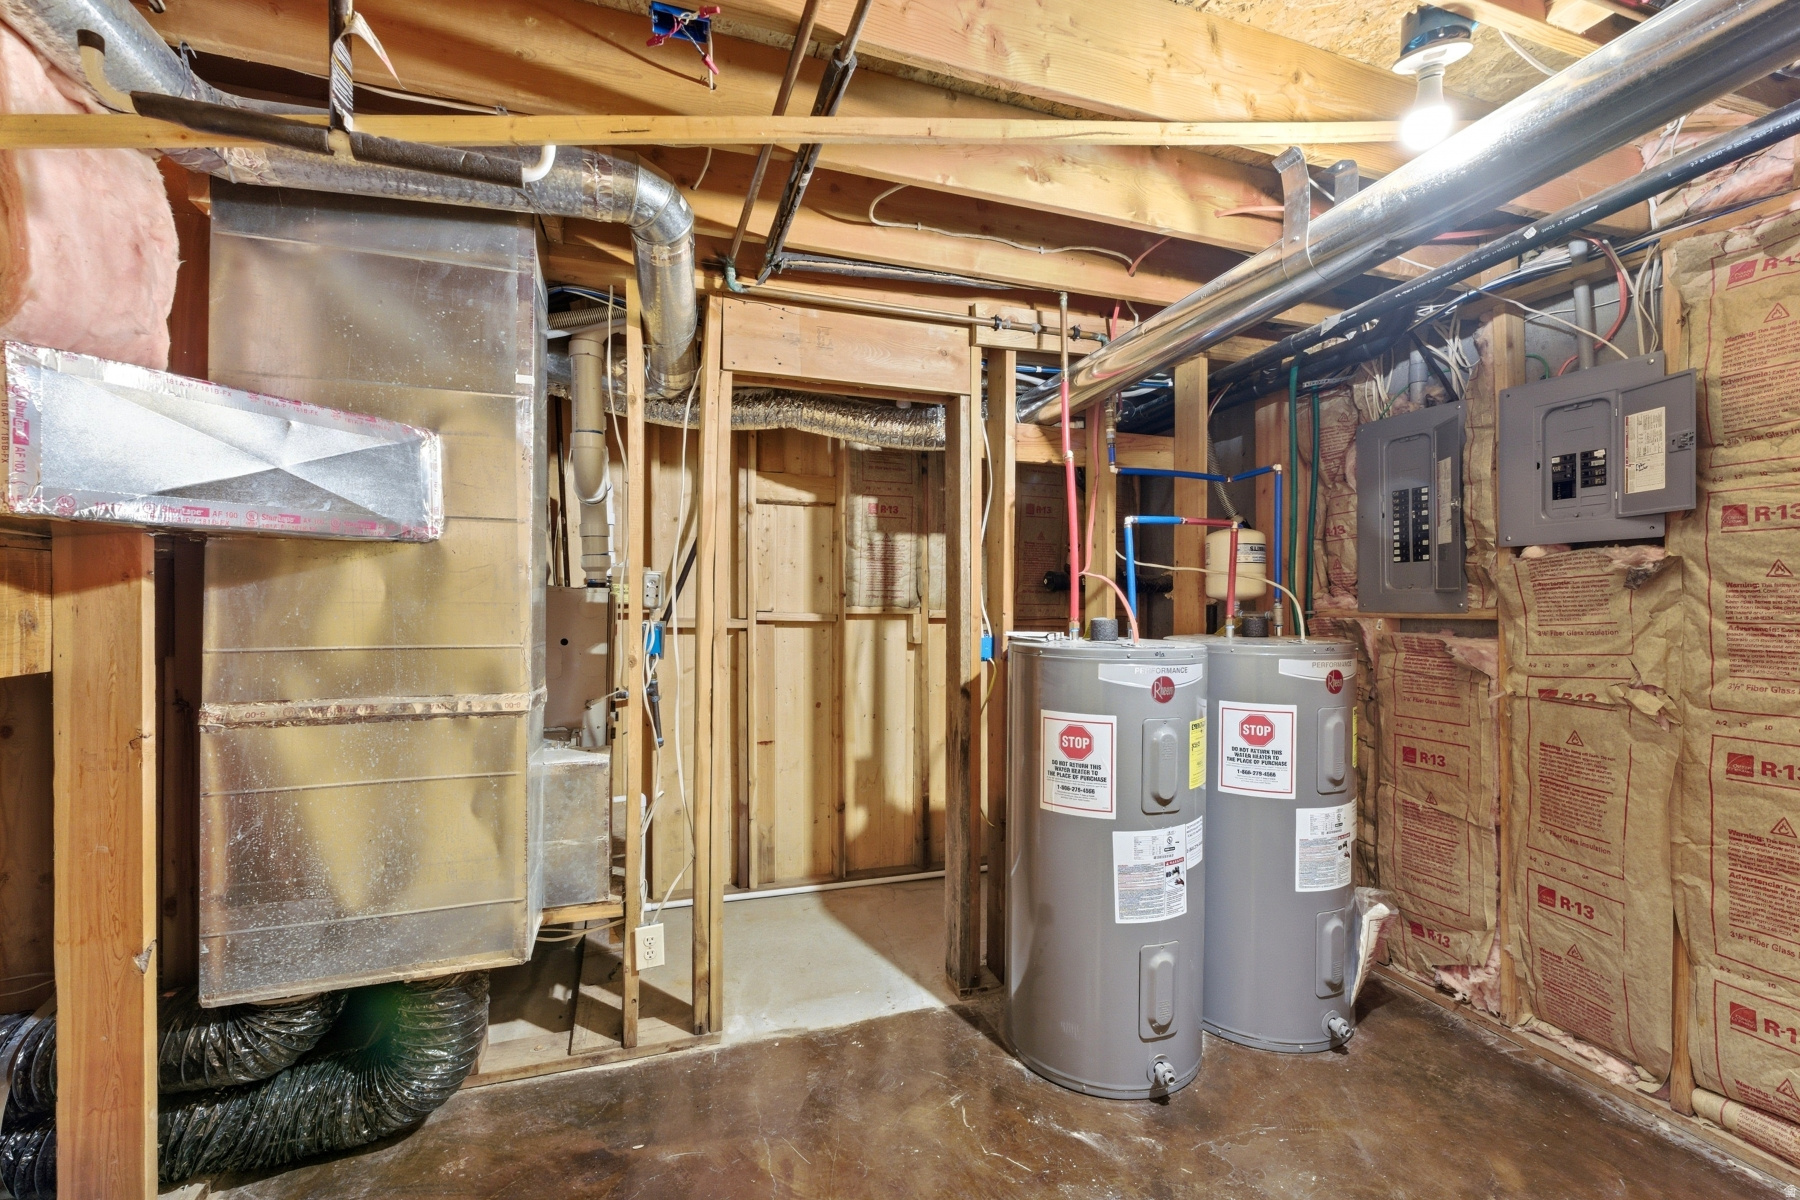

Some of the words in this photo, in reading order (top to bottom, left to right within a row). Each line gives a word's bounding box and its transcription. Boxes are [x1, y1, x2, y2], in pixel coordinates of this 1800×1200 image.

[1744, 434, 1764, 442] Fiber
[1765, 430, 1788, 439] Glass
[880, 505, 899, 514] R-13
[1154, 678, 1174, 699] Rheem
[1746, 684, 1768, 693] Fiber
[1771, 686, 1796, 694] Glass
[1242, 724, 1271, 736] STOP
[1062, 736, 1090, 749] STOP
[1420, 752, 1446, 767] R-13
[1761, 761, 1800, 780] R-1
[1563, 835, 1579, 845] Glass
[1580, 841, 1611, 855] Insulation
[1729, 872, 1783, 889] Advertencia:
[1560, 896, 1594, 920] R-13
[1428, 928, 1450, 948] R-13
[1748, 936, 1769, 949] Fiber
[1772, 943, 1795, 957] Glass
[1764, 1018, 1800, 1045] R-1
